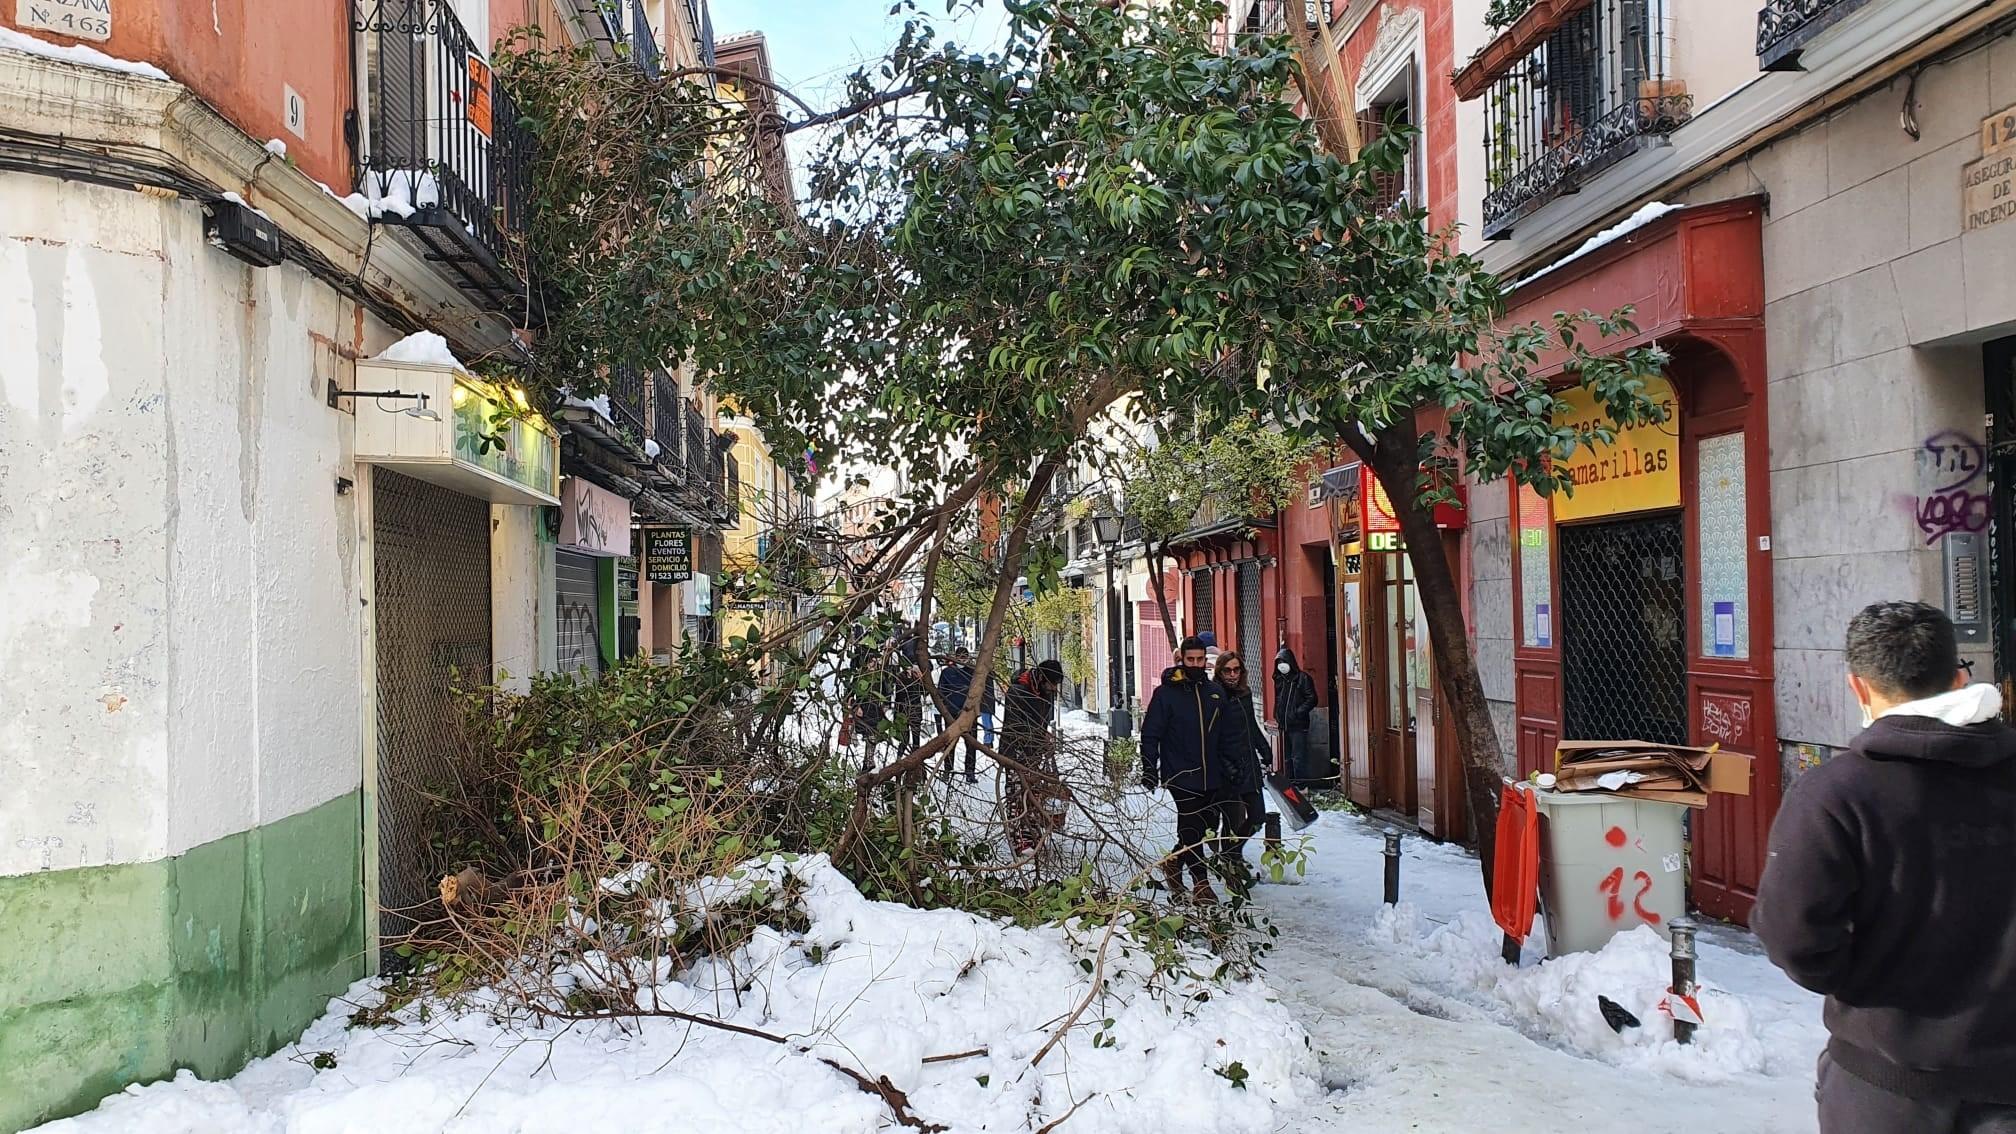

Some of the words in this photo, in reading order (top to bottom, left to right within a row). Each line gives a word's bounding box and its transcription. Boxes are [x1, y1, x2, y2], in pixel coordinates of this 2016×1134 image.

[61, 13, 108, 35] 463
[291, 95, 298, 127] 9
[1993, 180, 2011, 200] DE
[1568, 447, 1668, 487] amarillas
[651, 531, 685, 539] PLANTAS
[654, 539, 684, 547] FLORES
[1369, 532, 1397, 550] DE
[648, 556, 680, 564] SERVICIO
[683, 555, 689, 563] A
[652, 547, 686, 555] EVENTOS
[649, 572, 657, 580] 91
[658, 572, 672, 580] 523
[1597, 866, 1661, 924] 12
